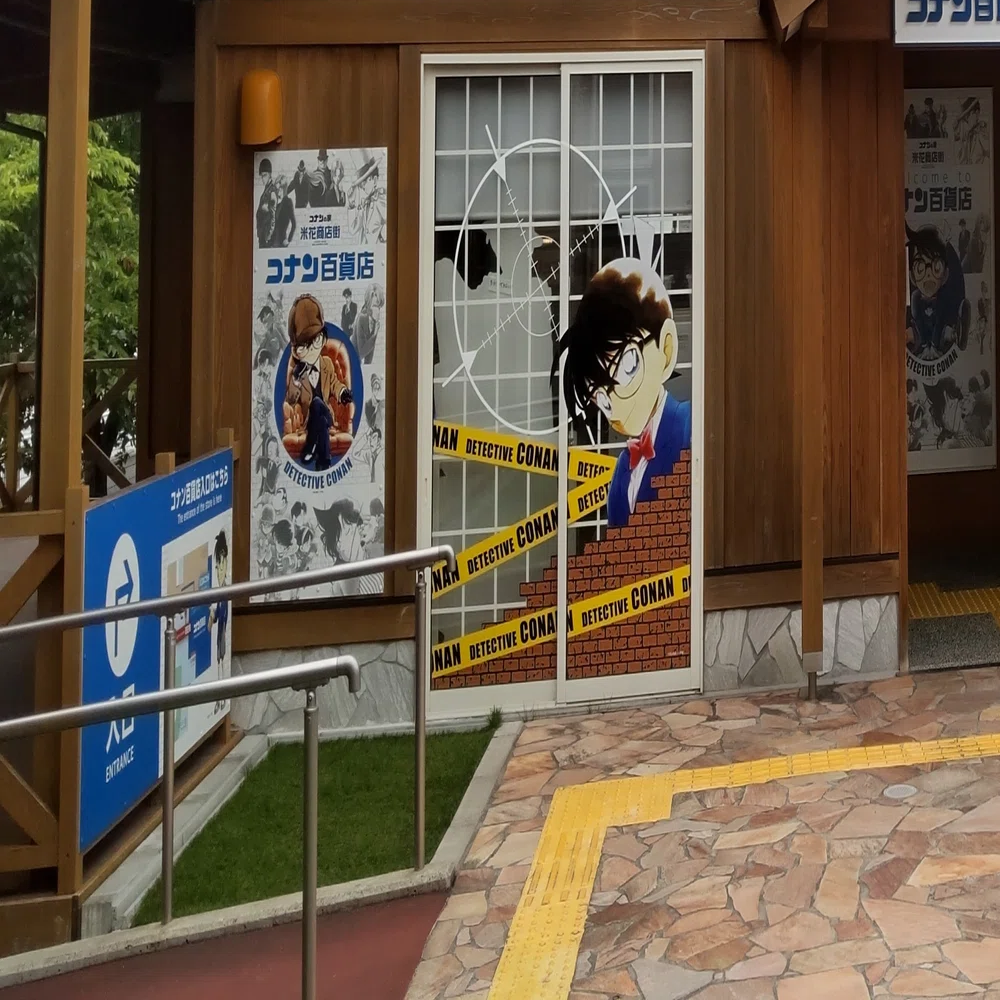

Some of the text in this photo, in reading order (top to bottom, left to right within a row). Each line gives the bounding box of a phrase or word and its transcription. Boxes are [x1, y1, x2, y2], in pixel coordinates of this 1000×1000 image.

[958, 171, 971, 183] to
[265, 251, 374, 284] コナン百貨店
[906, 348, 958, 377] ETECTIVE CONAN
[466, 438, 514, 463] DETECTIVE
[516, 442, 570, 472] CONAN
[170, 465, 229, 511] コナン百貨店入口はこちら
[283, 456, 353, 489] DETECTIVE CONAN
[432, 504, 570, 593] NAN DETECTIVE CONAN
[432, 643, 461, 673] NAN
[469, 631, 517, 661] DETECTIVE
[520, 609, 574, 643] CONAN
[581, 597, 629, 628] DETECTIVE
[631, 575, 675, 610] CONAN
[105, 744, 135, 783] ENTRANCE
